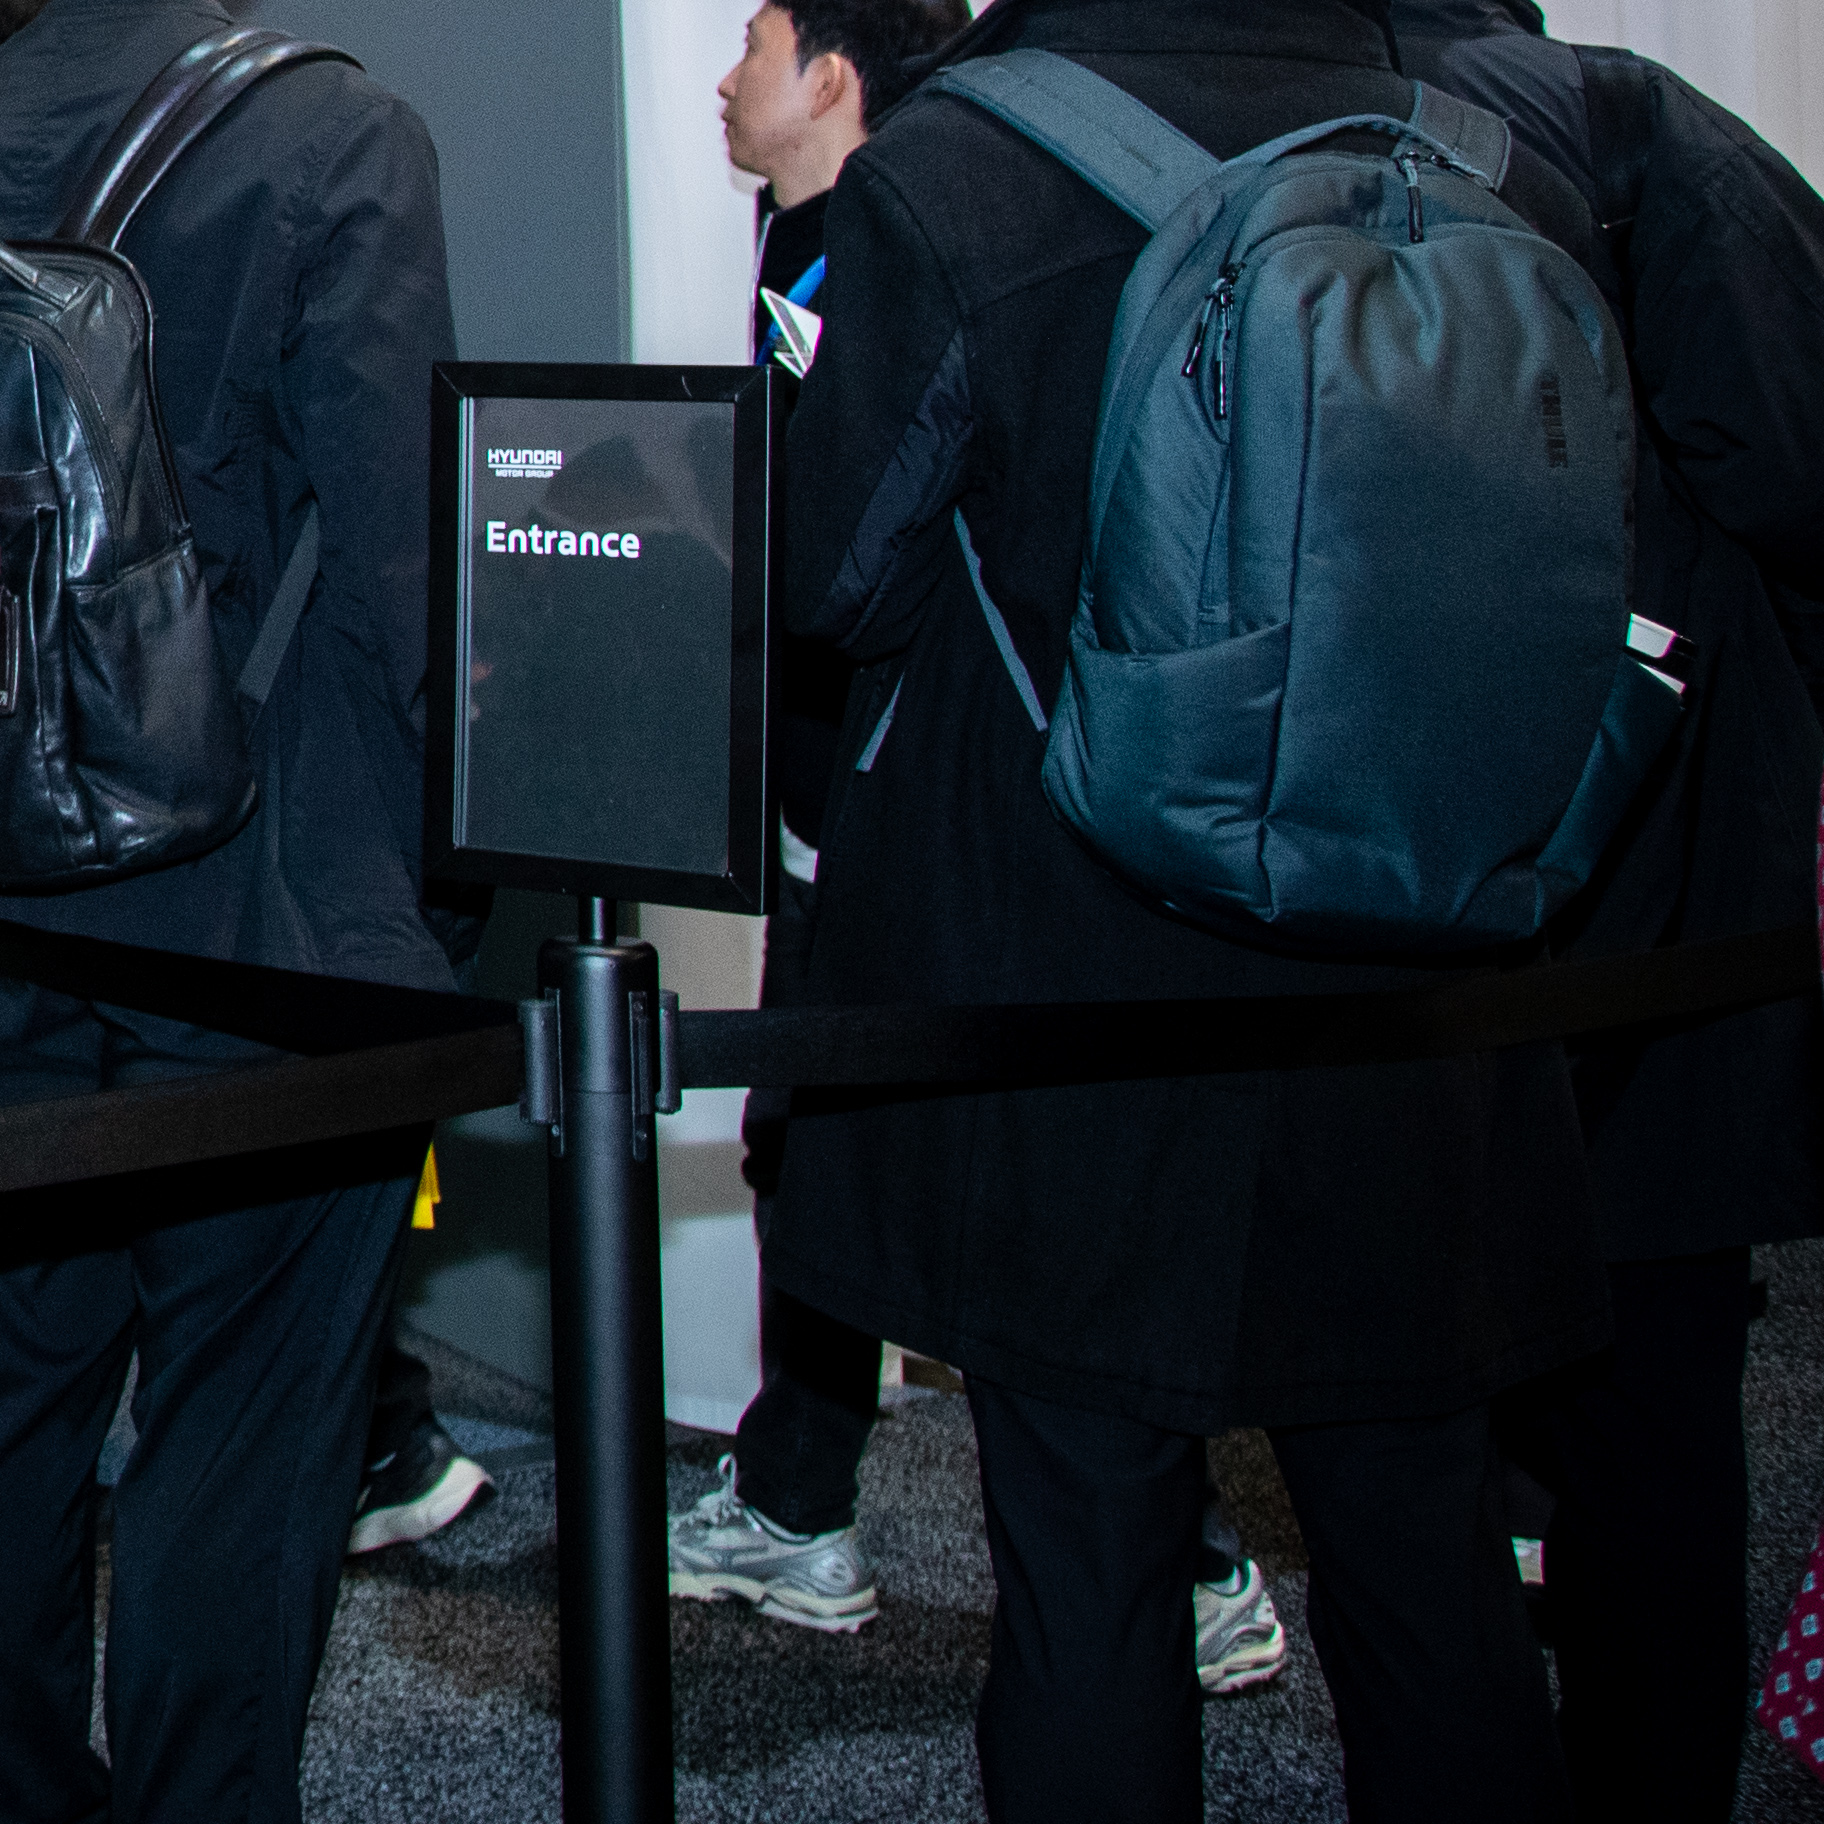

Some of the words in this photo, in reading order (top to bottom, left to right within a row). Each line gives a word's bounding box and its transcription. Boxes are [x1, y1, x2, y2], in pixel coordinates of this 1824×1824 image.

[1540, 374, 1569, 468] THULE
[487, 448, 563, 465] HYUNDAI
[486, 520, 641, 559] Entrance
